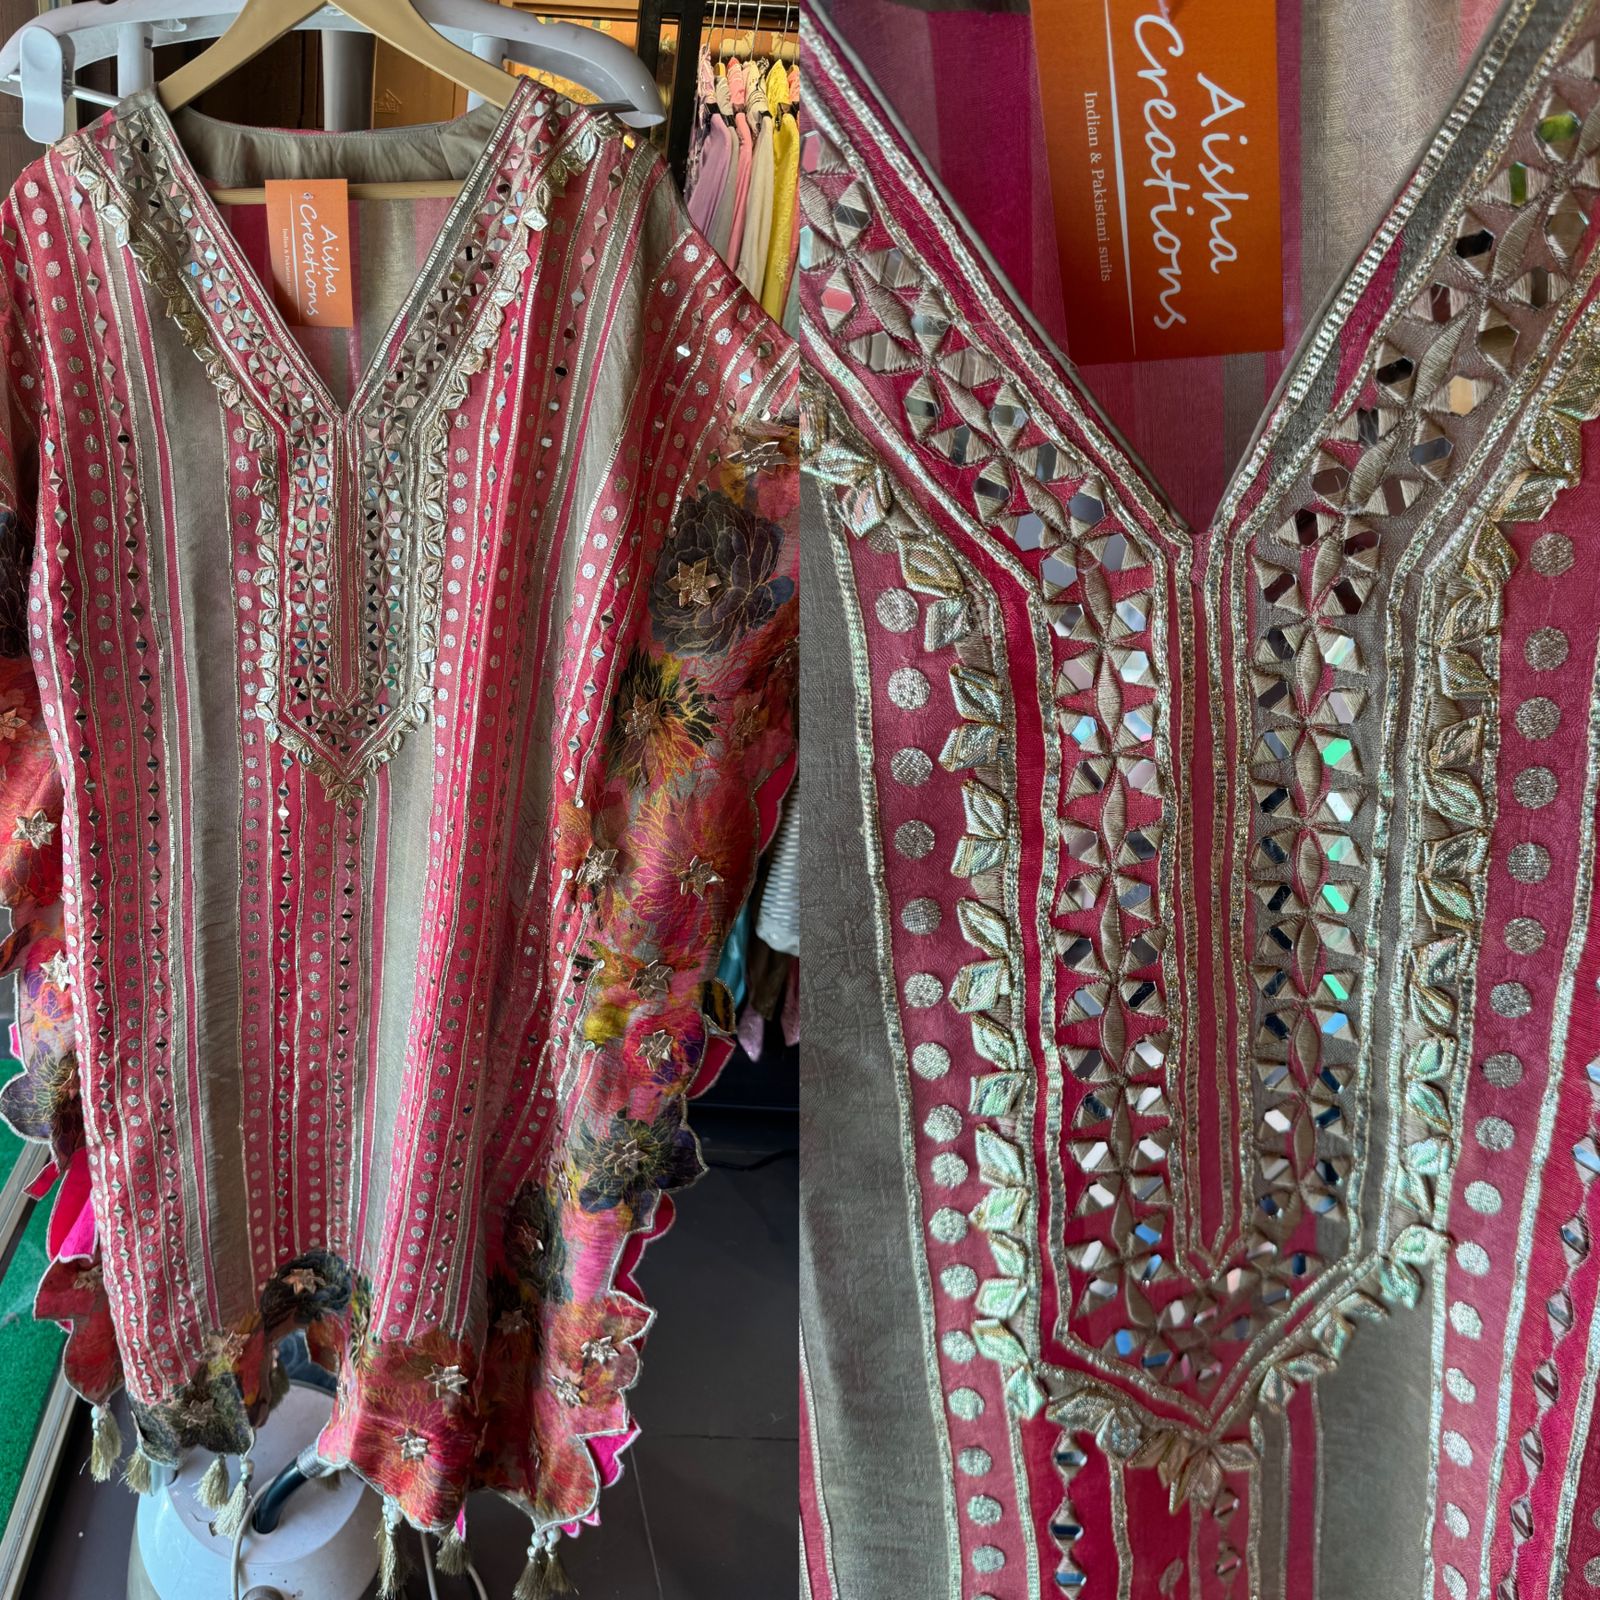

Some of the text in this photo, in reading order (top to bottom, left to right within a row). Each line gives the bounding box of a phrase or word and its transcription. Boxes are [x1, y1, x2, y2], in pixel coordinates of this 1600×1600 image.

[299, 203, 321, 316] Creations
[320, 224, 340, 297] Aisha
[1084, 91, 1112, 282] Indian & Pakistani suits
[1133, 14, 1195, 330] Creations
[1197, 72, 1249, 274] Aisha
